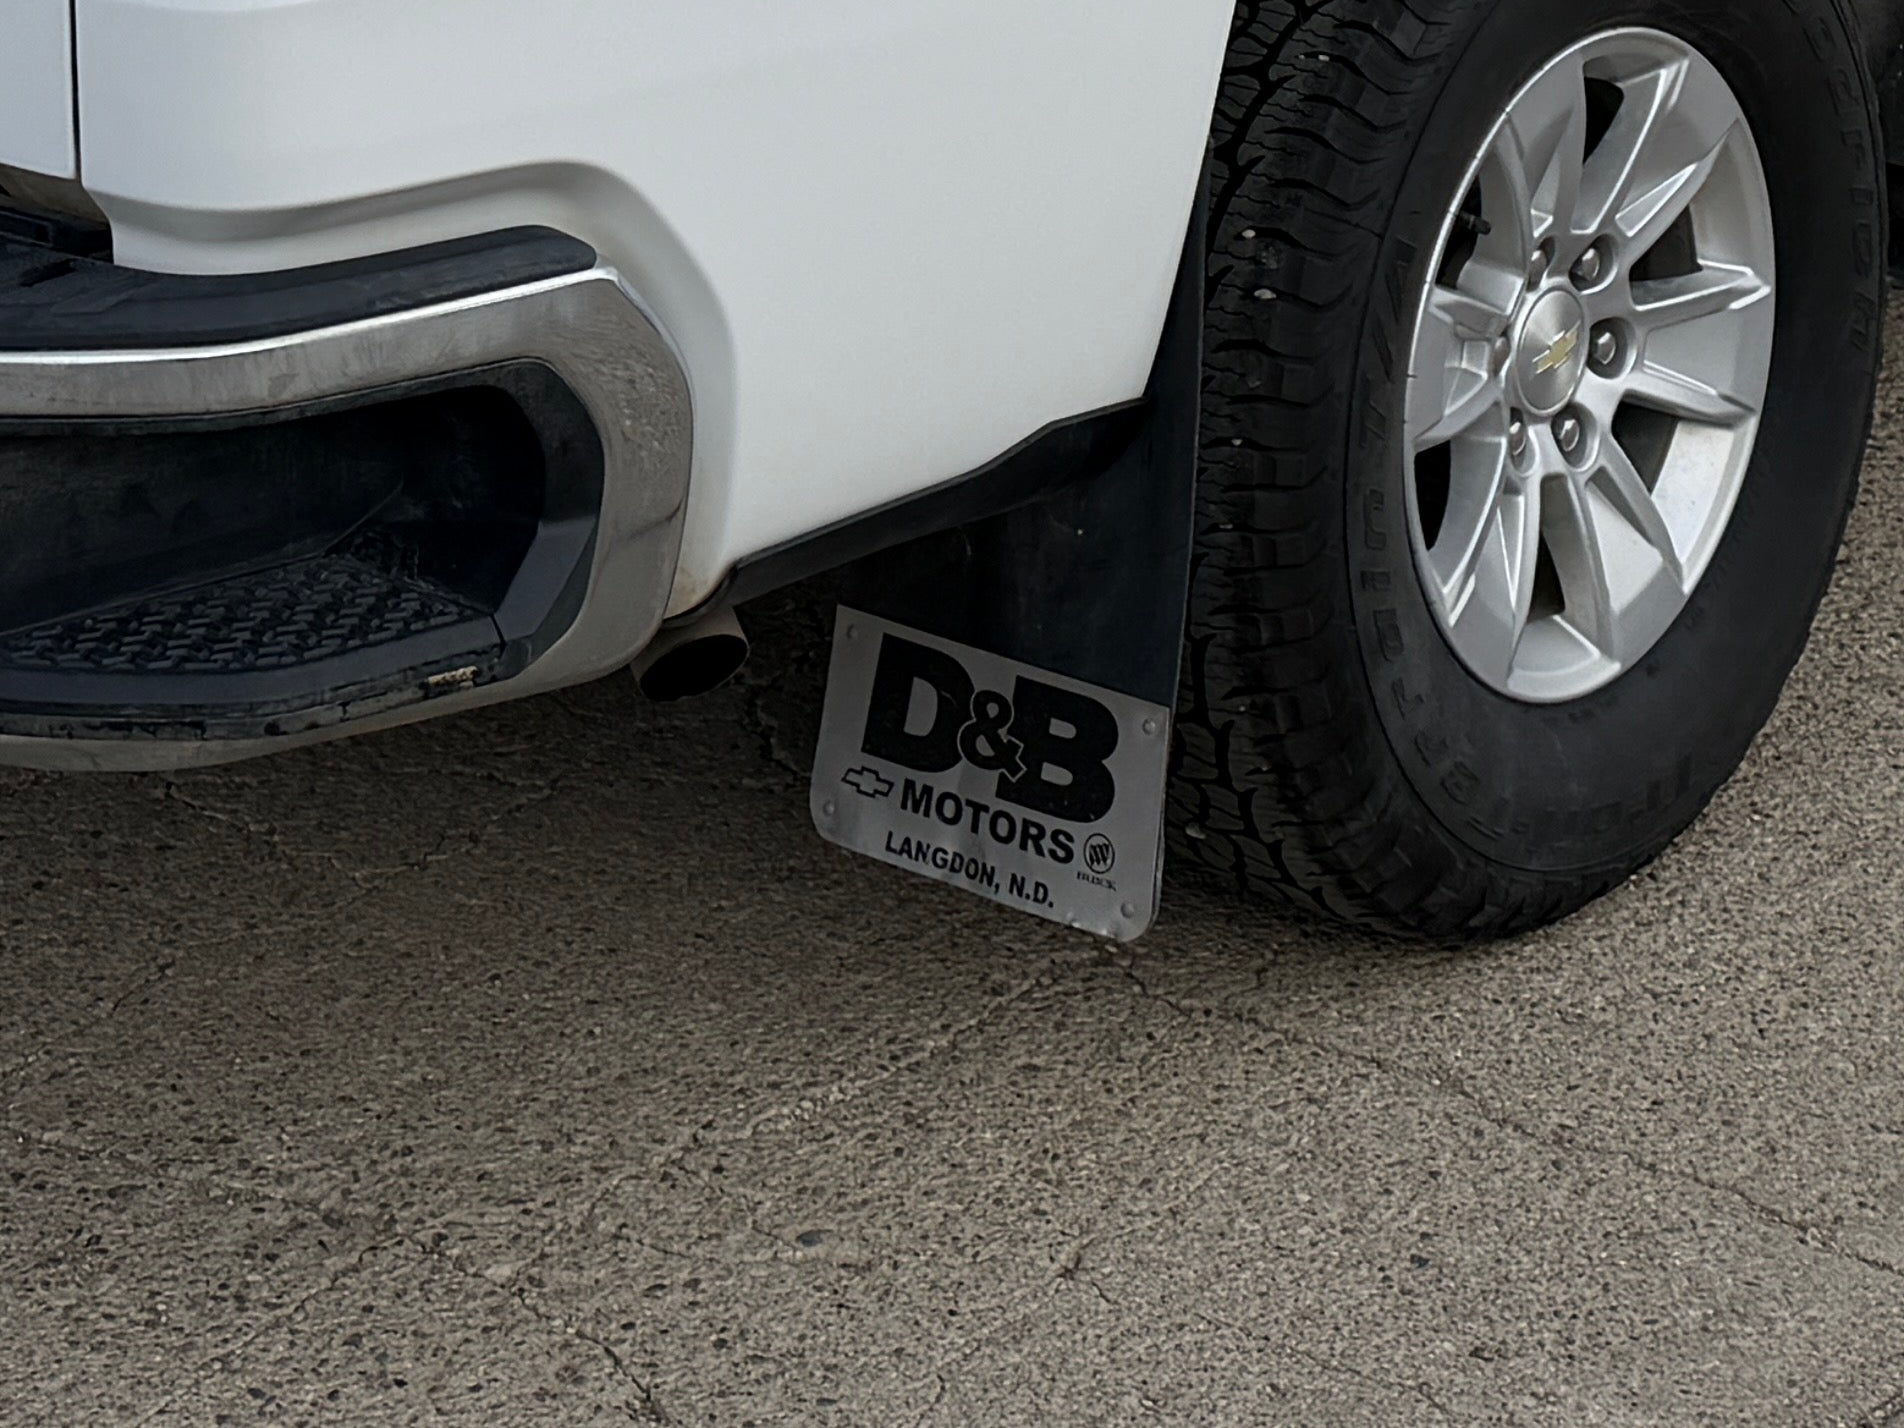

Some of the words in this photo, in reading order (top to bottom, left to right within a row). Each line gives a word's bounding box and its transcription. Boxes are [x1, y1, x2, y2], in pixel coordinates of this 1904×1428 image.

[860, 631, 1120, 824] D&B
[899, 777, 1076, 865] MOTORS
[884, 830, 1001, 896] LANGDON,
[1008, 872, 1056, 909] N.D.
